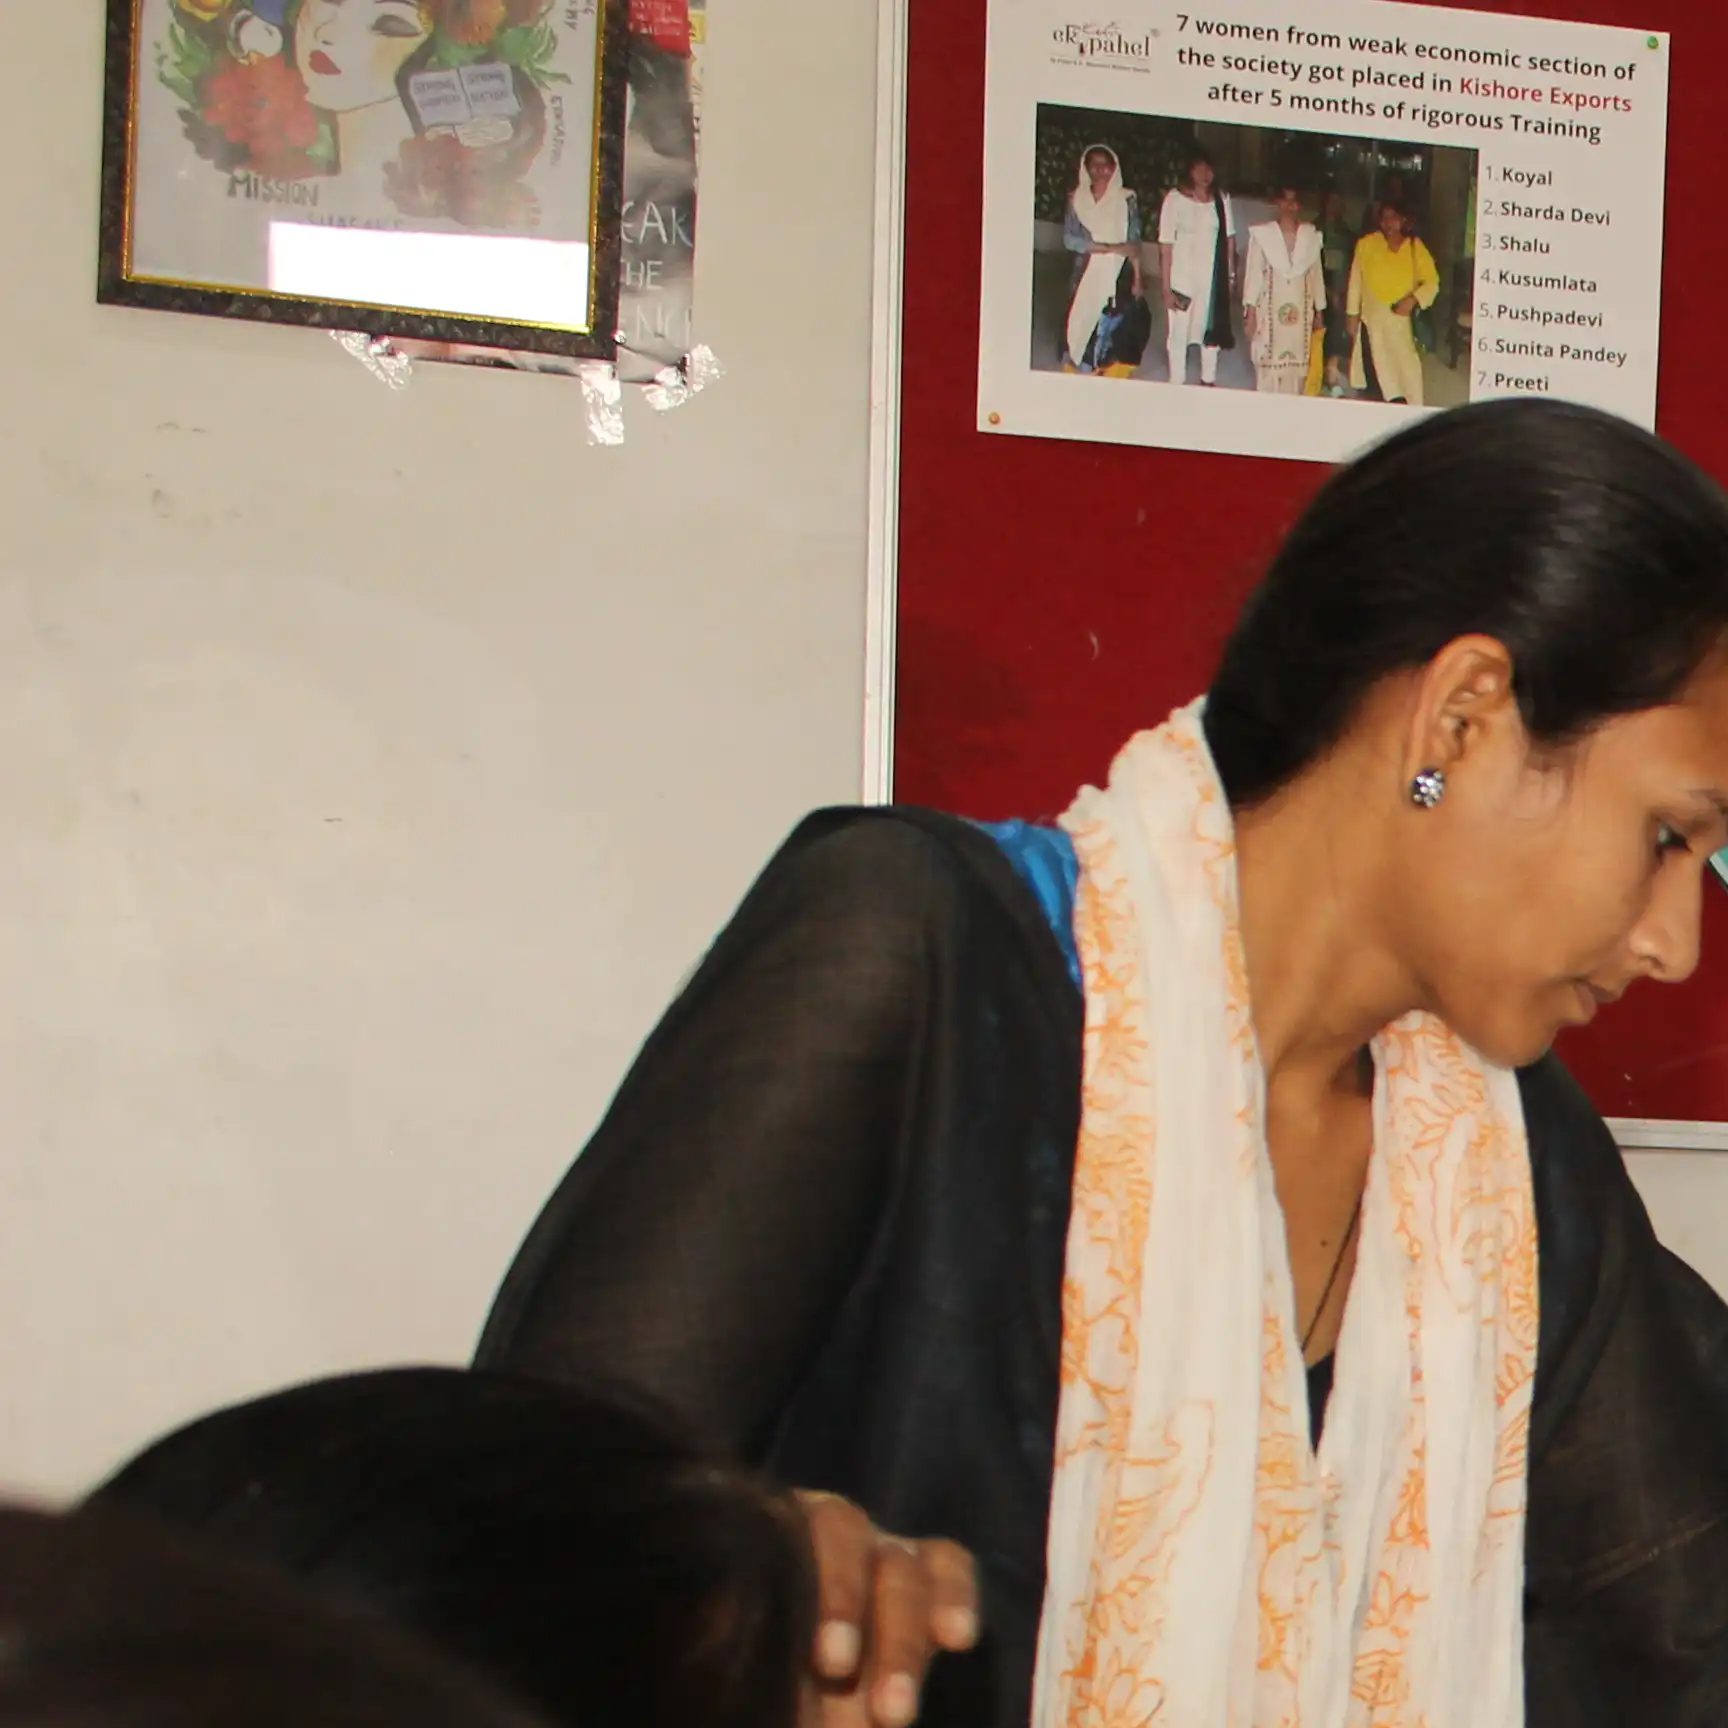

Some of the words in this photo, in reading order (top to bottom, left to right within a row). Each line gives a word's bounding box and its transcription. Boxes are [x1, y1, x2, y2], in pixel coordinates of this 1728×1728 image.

[1089, 34, 1149, 56] pahel
[1176, 14, 1189, 32] 7
[1196, 19, 1279, 42] women
[1287, 26, 1341, 49] from
[1349, 36, 1408, 57] weak
[1415, 43, 1521, 68] economic
[1528, 55, 1606, 78] section
[1614, 63, 1636, 81] of
[1177, 47, 1215, 67] the
[1222, 55, 1302, 81] society
[1309, 64, 1345, 84] got
[1352, 66, 1425, 89] placed
[1432, 73, 1452, 93] in
[1460, 77, 1542, 102] Kishore
[1551, 87, 1632, 112] Exports
[1208, 84, 1263, 105] after
[1270, 89, 1282, 107] 5
[1290, 94, 1375, 117] months
[1383, 101, 1405, 120] of
[1412, 104, 1503, 130] rigorous
[1511, 114, 1601, 145] Training
[1486, 165, 1499, 181] 1.
[1502, 167, 1553, 188] Koyal
[621, 201, 693, 247] EAK
[1483, 200, 1498, 216] 2.
[1500, 201, 1565, 221] Sharda
[1571, 208, 1611, 226] Devi
[1482, 234, 1496, 250] 3.
[1500, 236, 1550, 254] Shalu
[621, 259, 663, 290] HE
[1480, 269, 1496, 284] 4.
[1498, 270, 1598, 293] Kusumlata
[1479, 302, 1493, 318] 5.
[1497, 304, 1603, 327] Pushpadevi
[1478, 337, 1492, 352] 6.
[1495, 339, 1554, 358] Sunita
[1560, 344, 1628, 368] Pandey
[1477, 371, 1491, 387] 7.
[1494, 373, 1549, 391] Preeti
